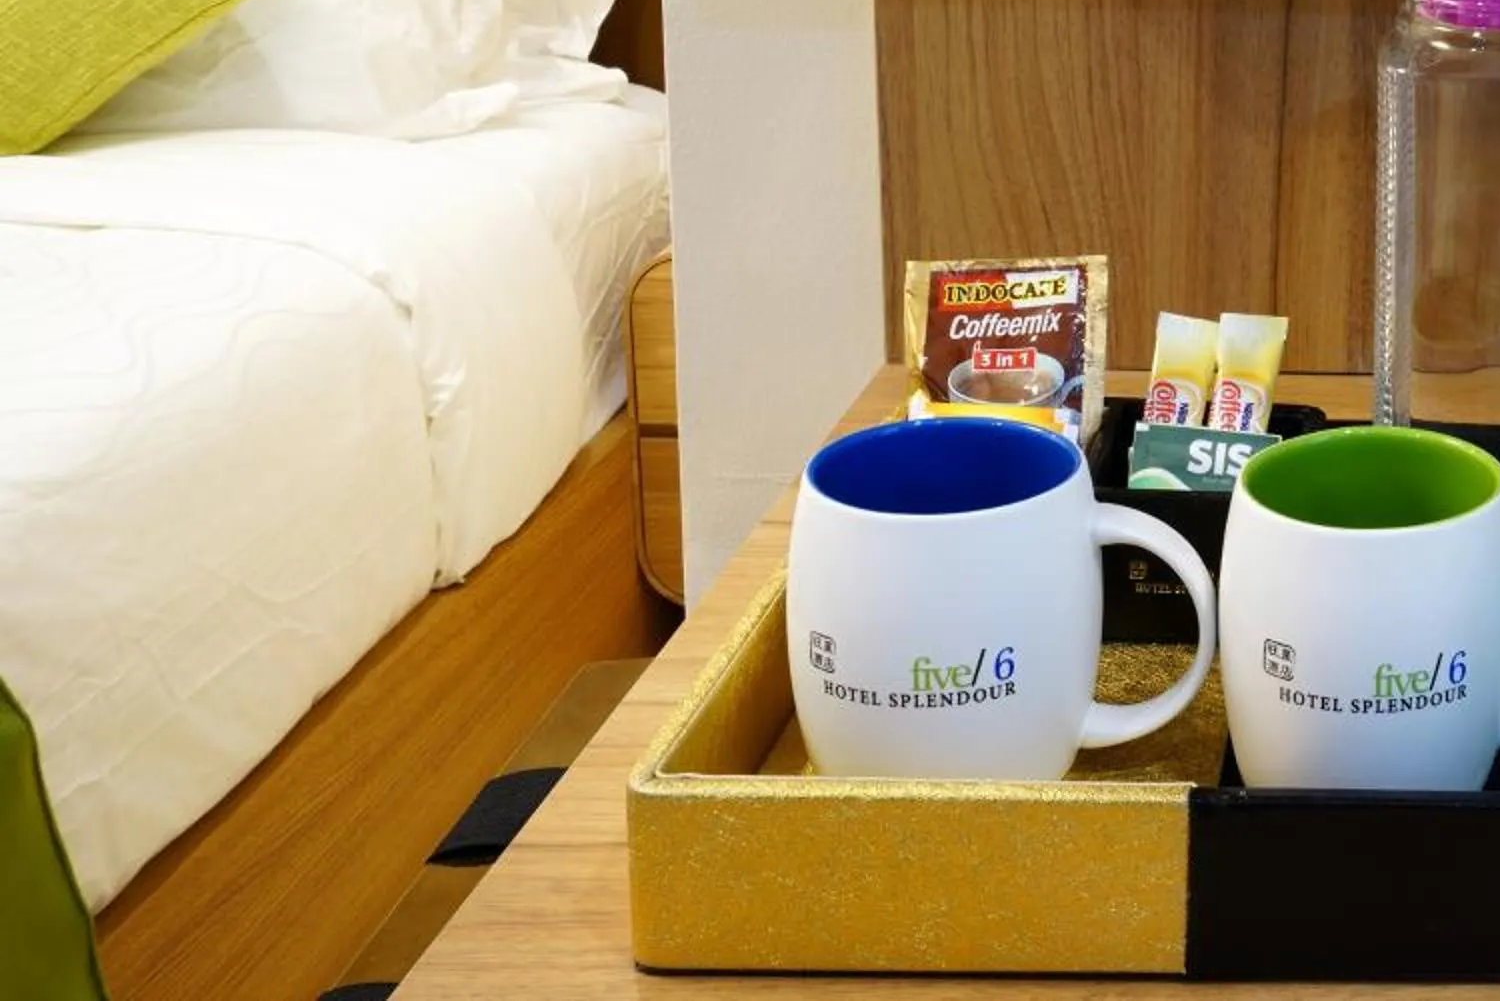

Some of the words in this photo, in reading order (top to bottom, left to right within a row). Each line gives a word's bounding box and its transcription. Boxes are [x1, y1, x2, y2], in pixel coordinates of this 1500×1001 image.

[949, 309, 1062, 339] Coffeemix
[980, 354, 991, 366] 3
[996, 352, 1013, 366] in
[1019, 352, 1028, 365] 1
[823, 679, 881, 706] HOTEL
[889, 680, 1017, 709] SPLENDOUR
[1279, 686, 1342, 712] HOTEL
[1350, 684, 1468, 714] SPLENDOUR
